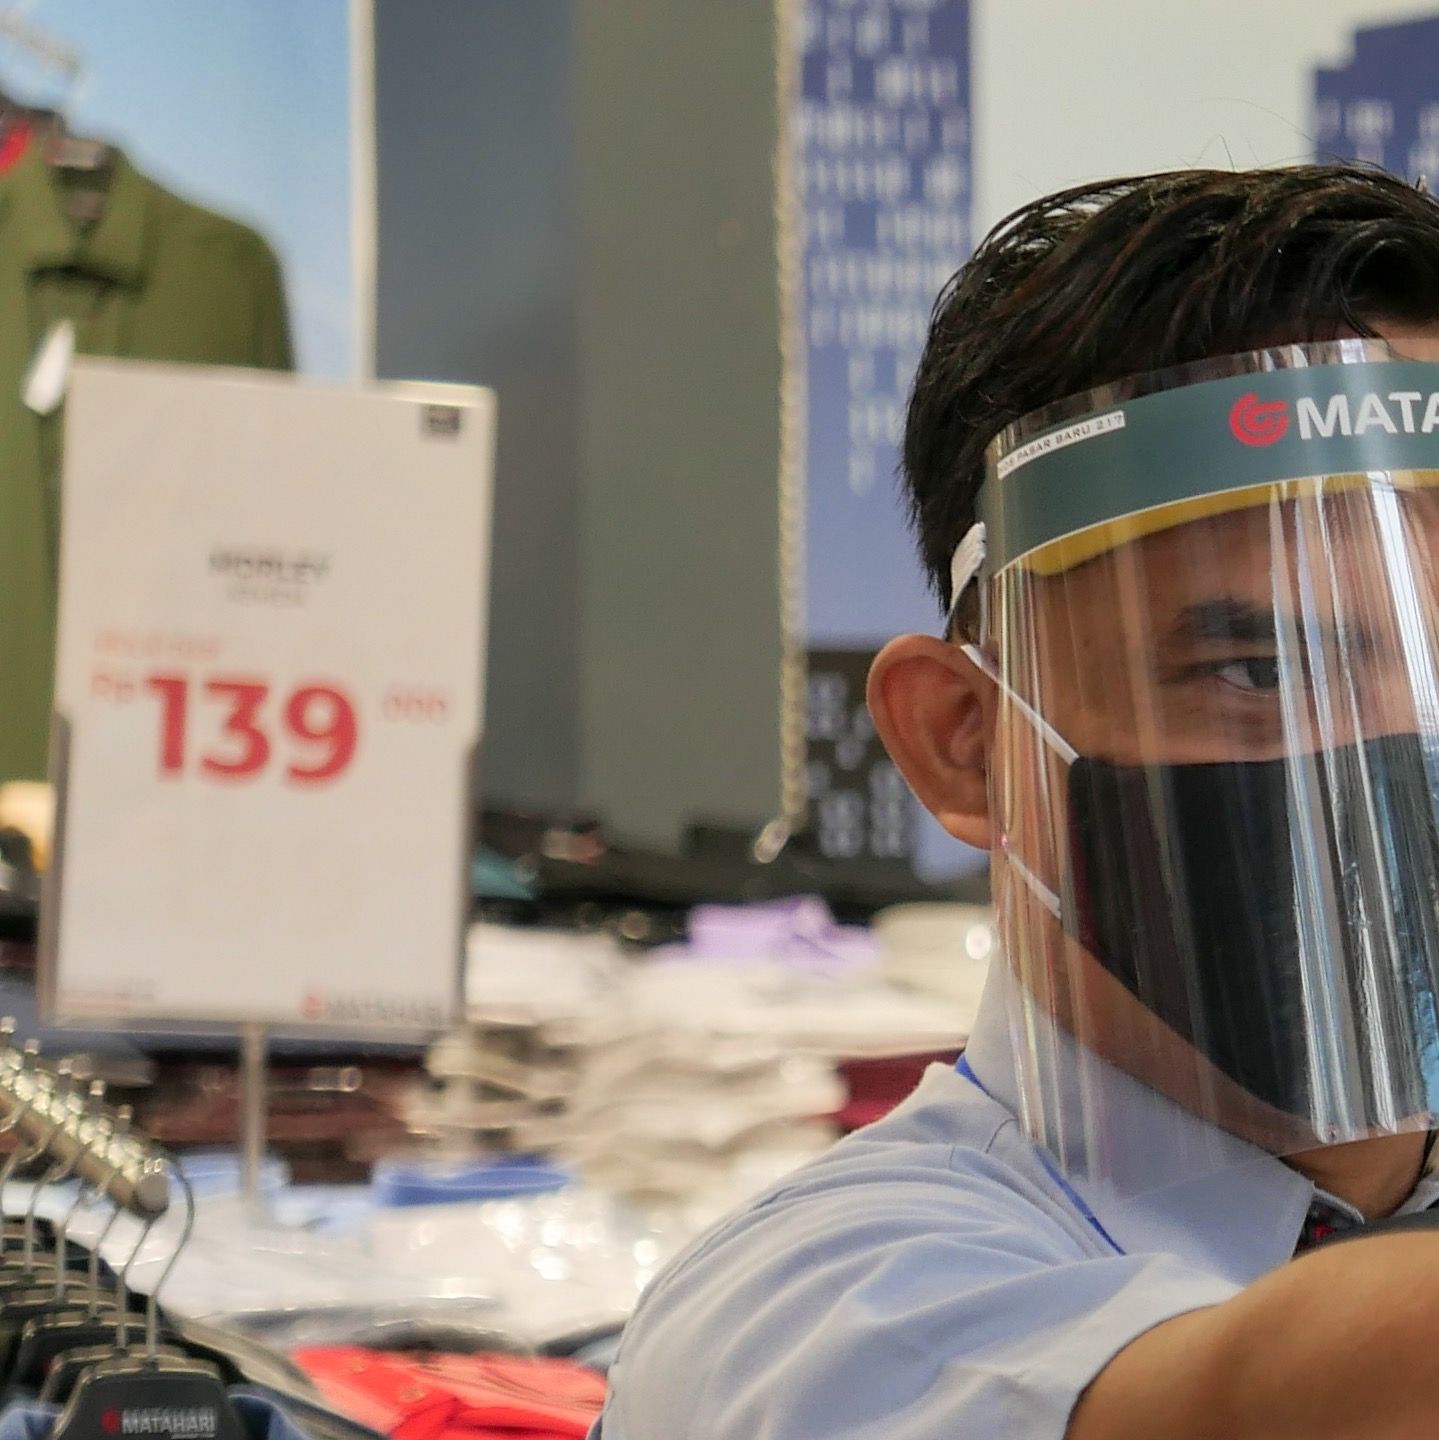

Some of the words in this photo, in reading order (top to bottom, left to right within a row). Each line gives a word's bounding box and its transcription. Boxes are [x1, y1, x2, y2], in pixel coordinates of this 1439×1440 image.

[1055, 425, 1091, 443] BARU
[146, 674, 359, 780] 139
[121, 1408, 217, 1434] MATAHARI
